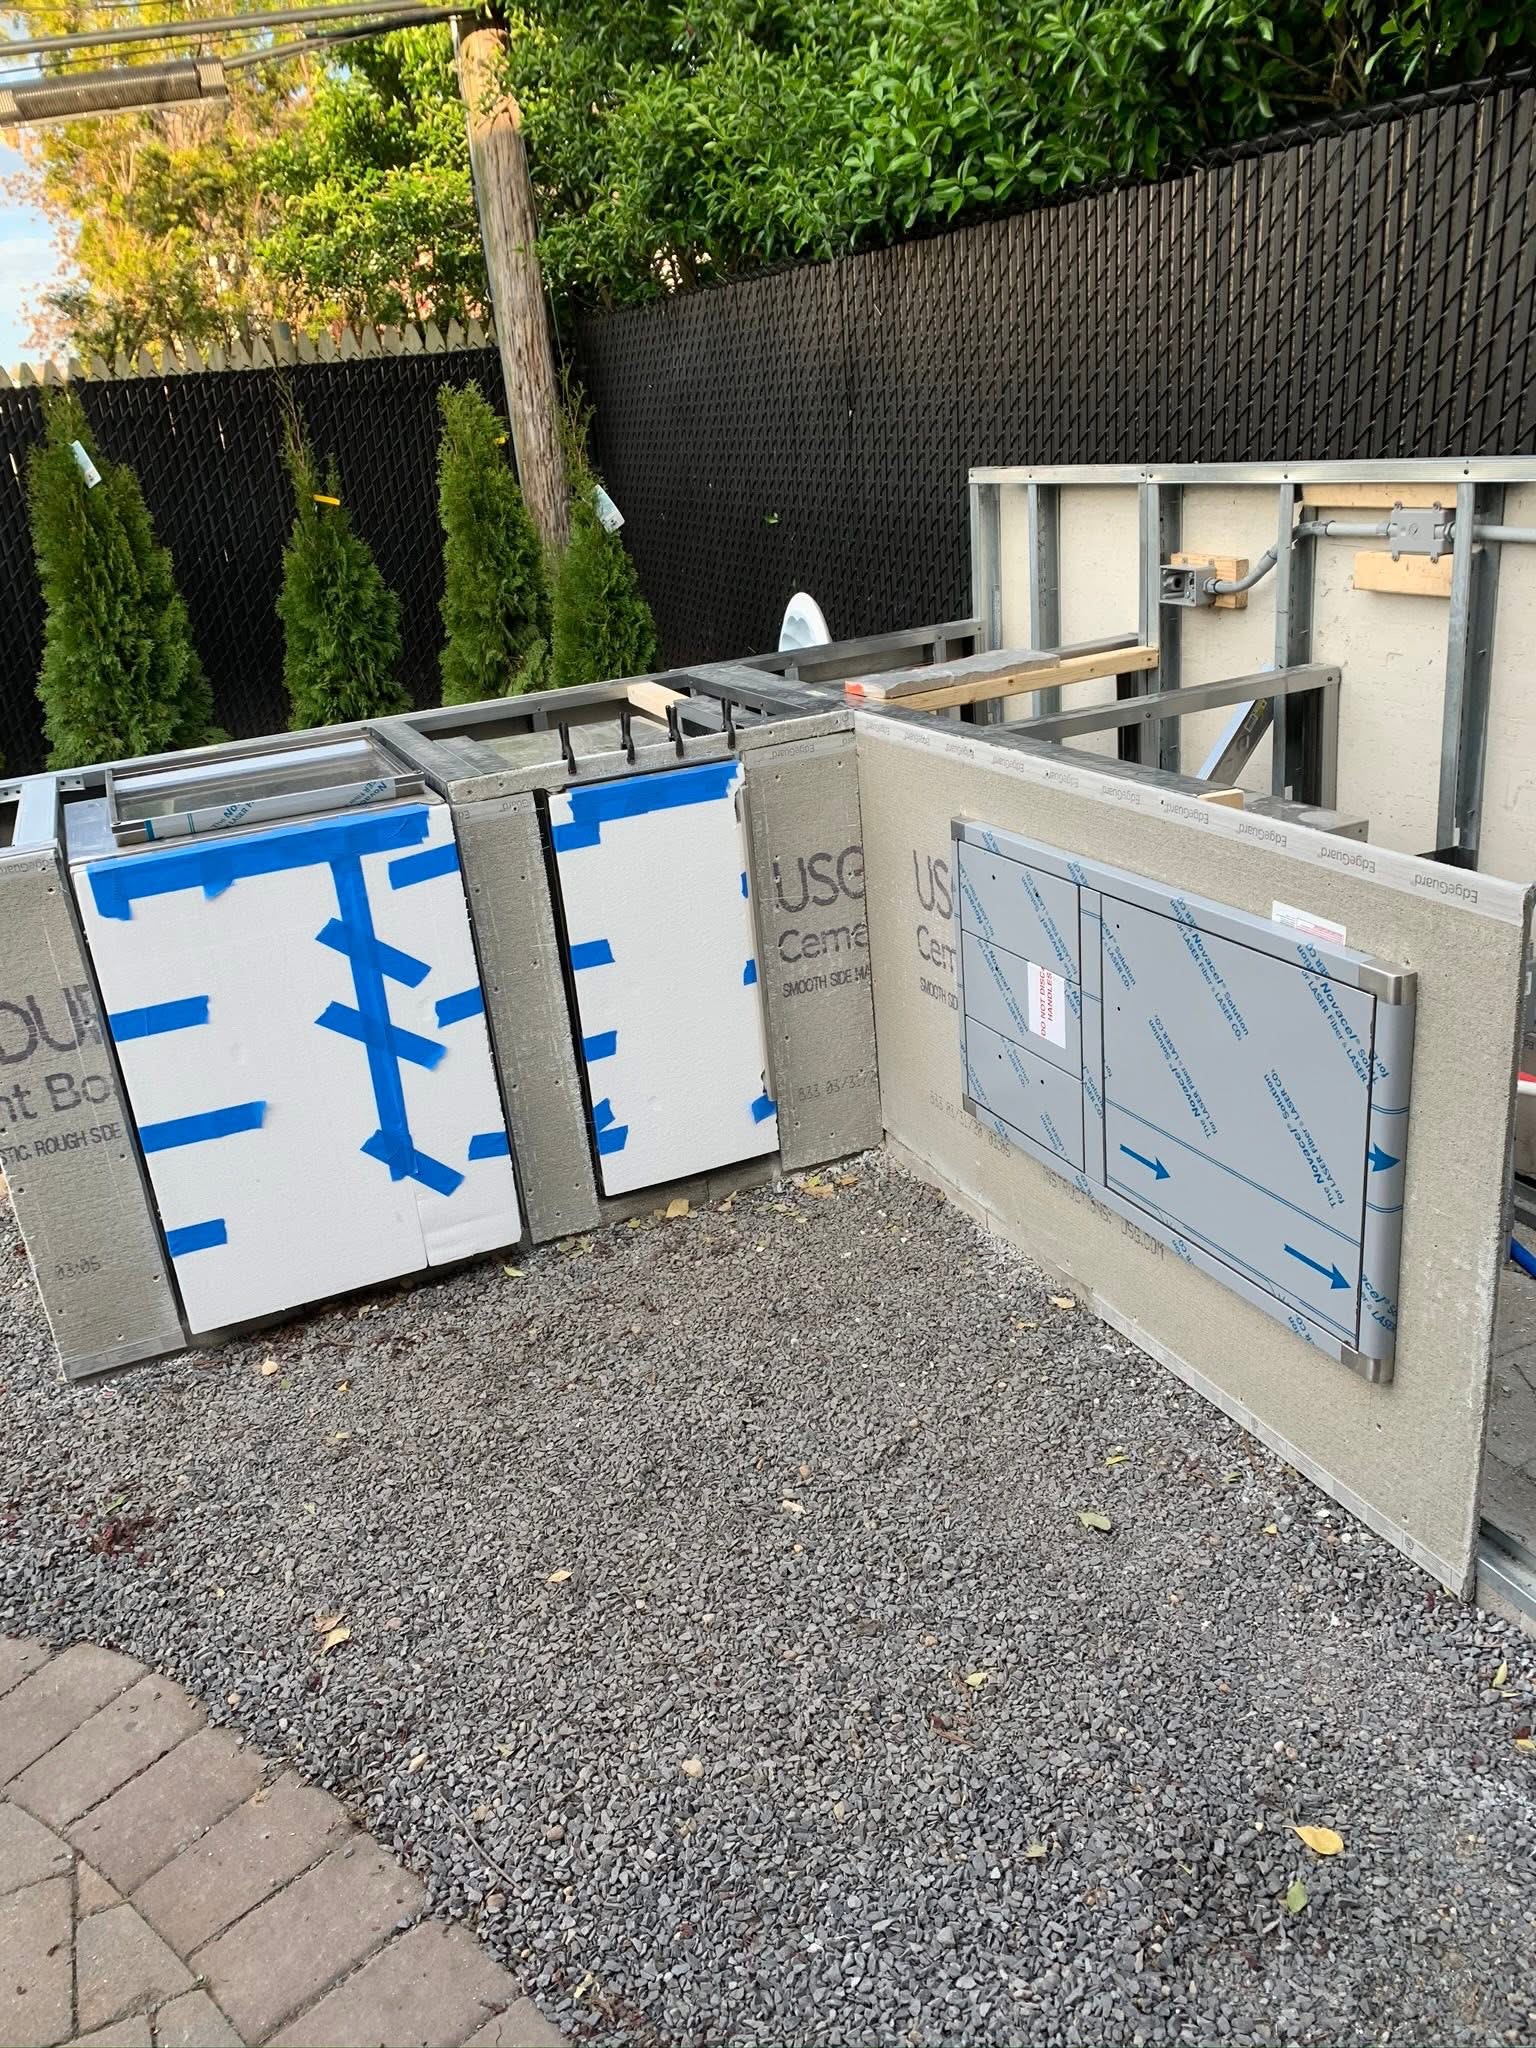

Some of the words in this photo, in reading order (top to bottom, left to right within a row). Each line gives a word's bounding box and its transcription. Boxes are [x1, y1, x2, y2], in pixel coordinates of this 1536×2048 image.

[1046, 972, 1054, 1022] HANDLES
[1182, 933, 1200, 962] LASER
[1214, 992, 1233, 1023] LASER
[1223, 991, 1249, 1036] Solution
[1308, 980, 1328, 1014] LASER
[1346, 1048, 1368, 1082] LASER
[1264, 1074, 1290, 1120] Solution
[1280, 1088, 1300, 1121] LASER
[36, 1133, 88, 1157] ROUGH
[90, 1122, 123, 1143] SIDE
[1315, 1155, 1337, 1188] LASER
